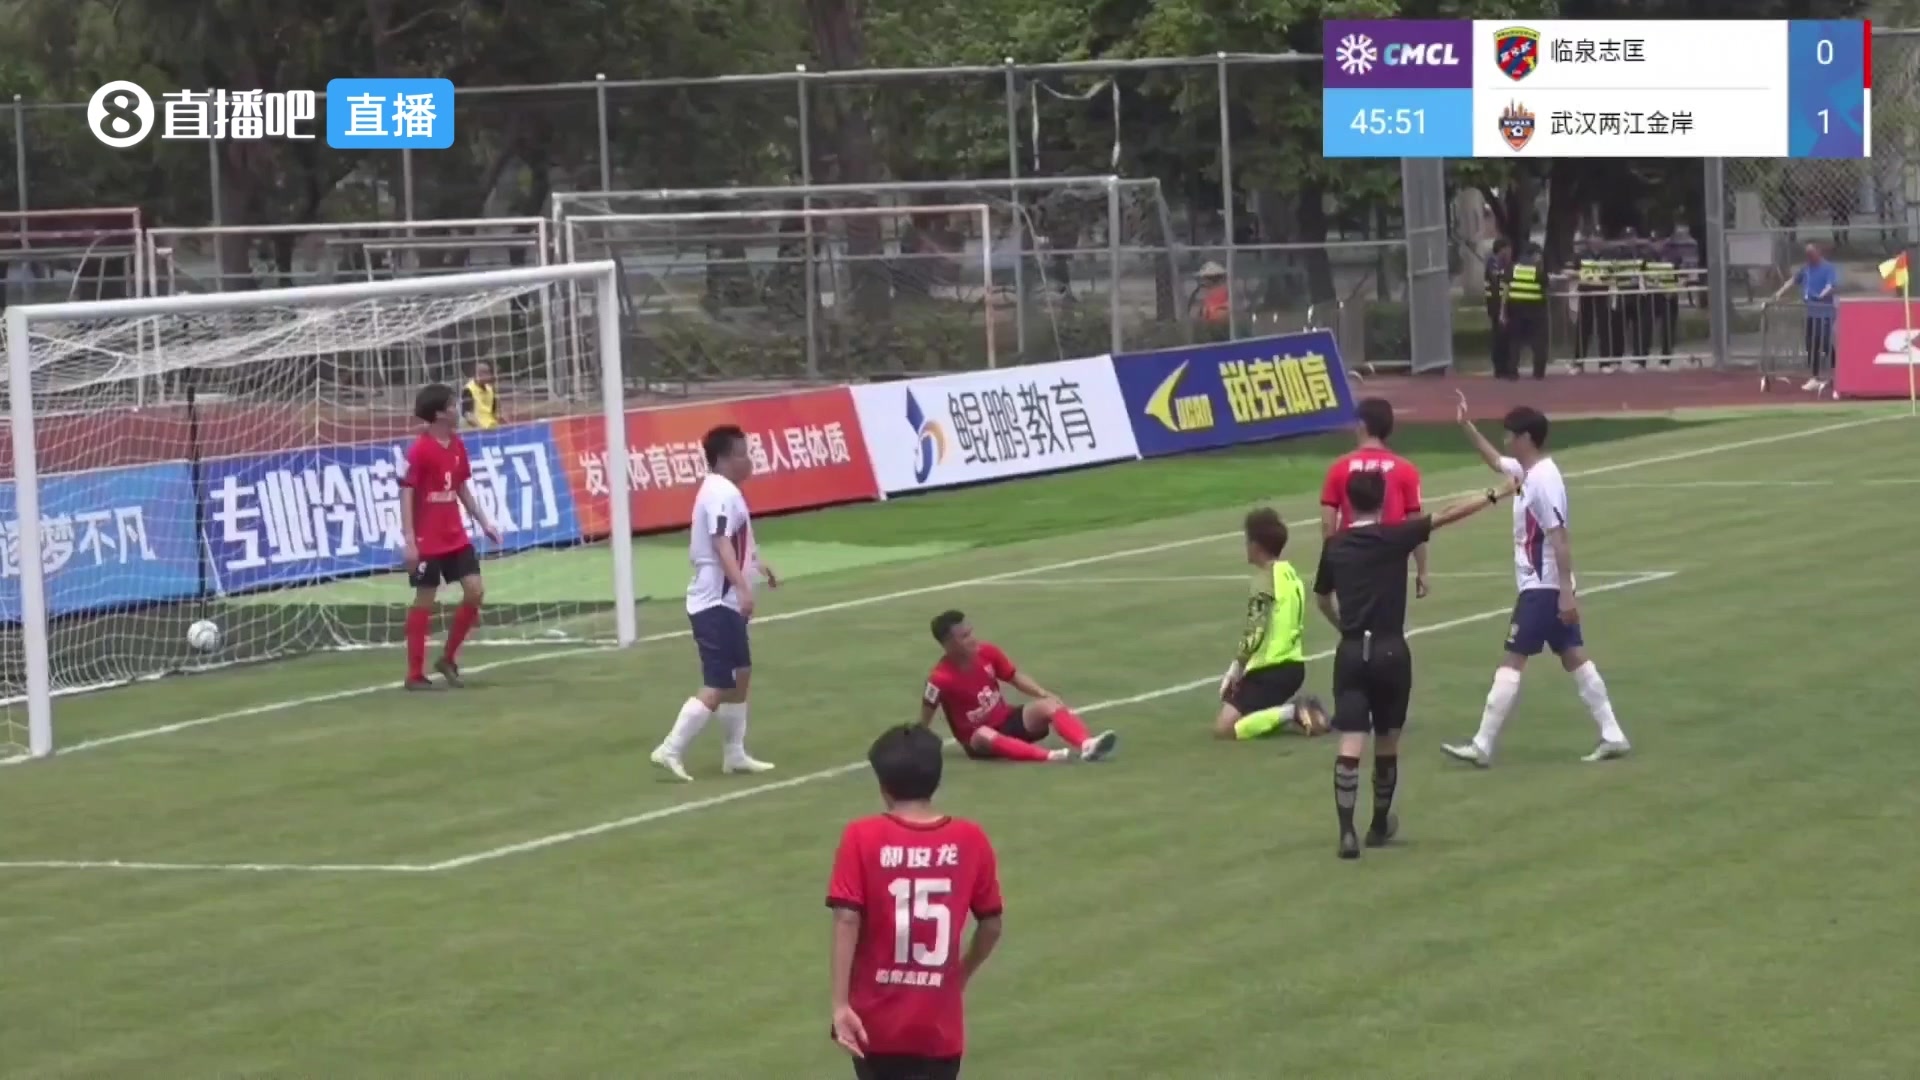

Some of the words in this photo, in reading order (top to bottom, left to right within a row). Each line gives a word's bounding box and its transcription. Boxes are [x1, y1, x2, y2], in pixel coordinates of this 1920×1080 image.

[947, 377, 1097, 464] 鲲鹏教育
[888, 878, 952, 966] 15
